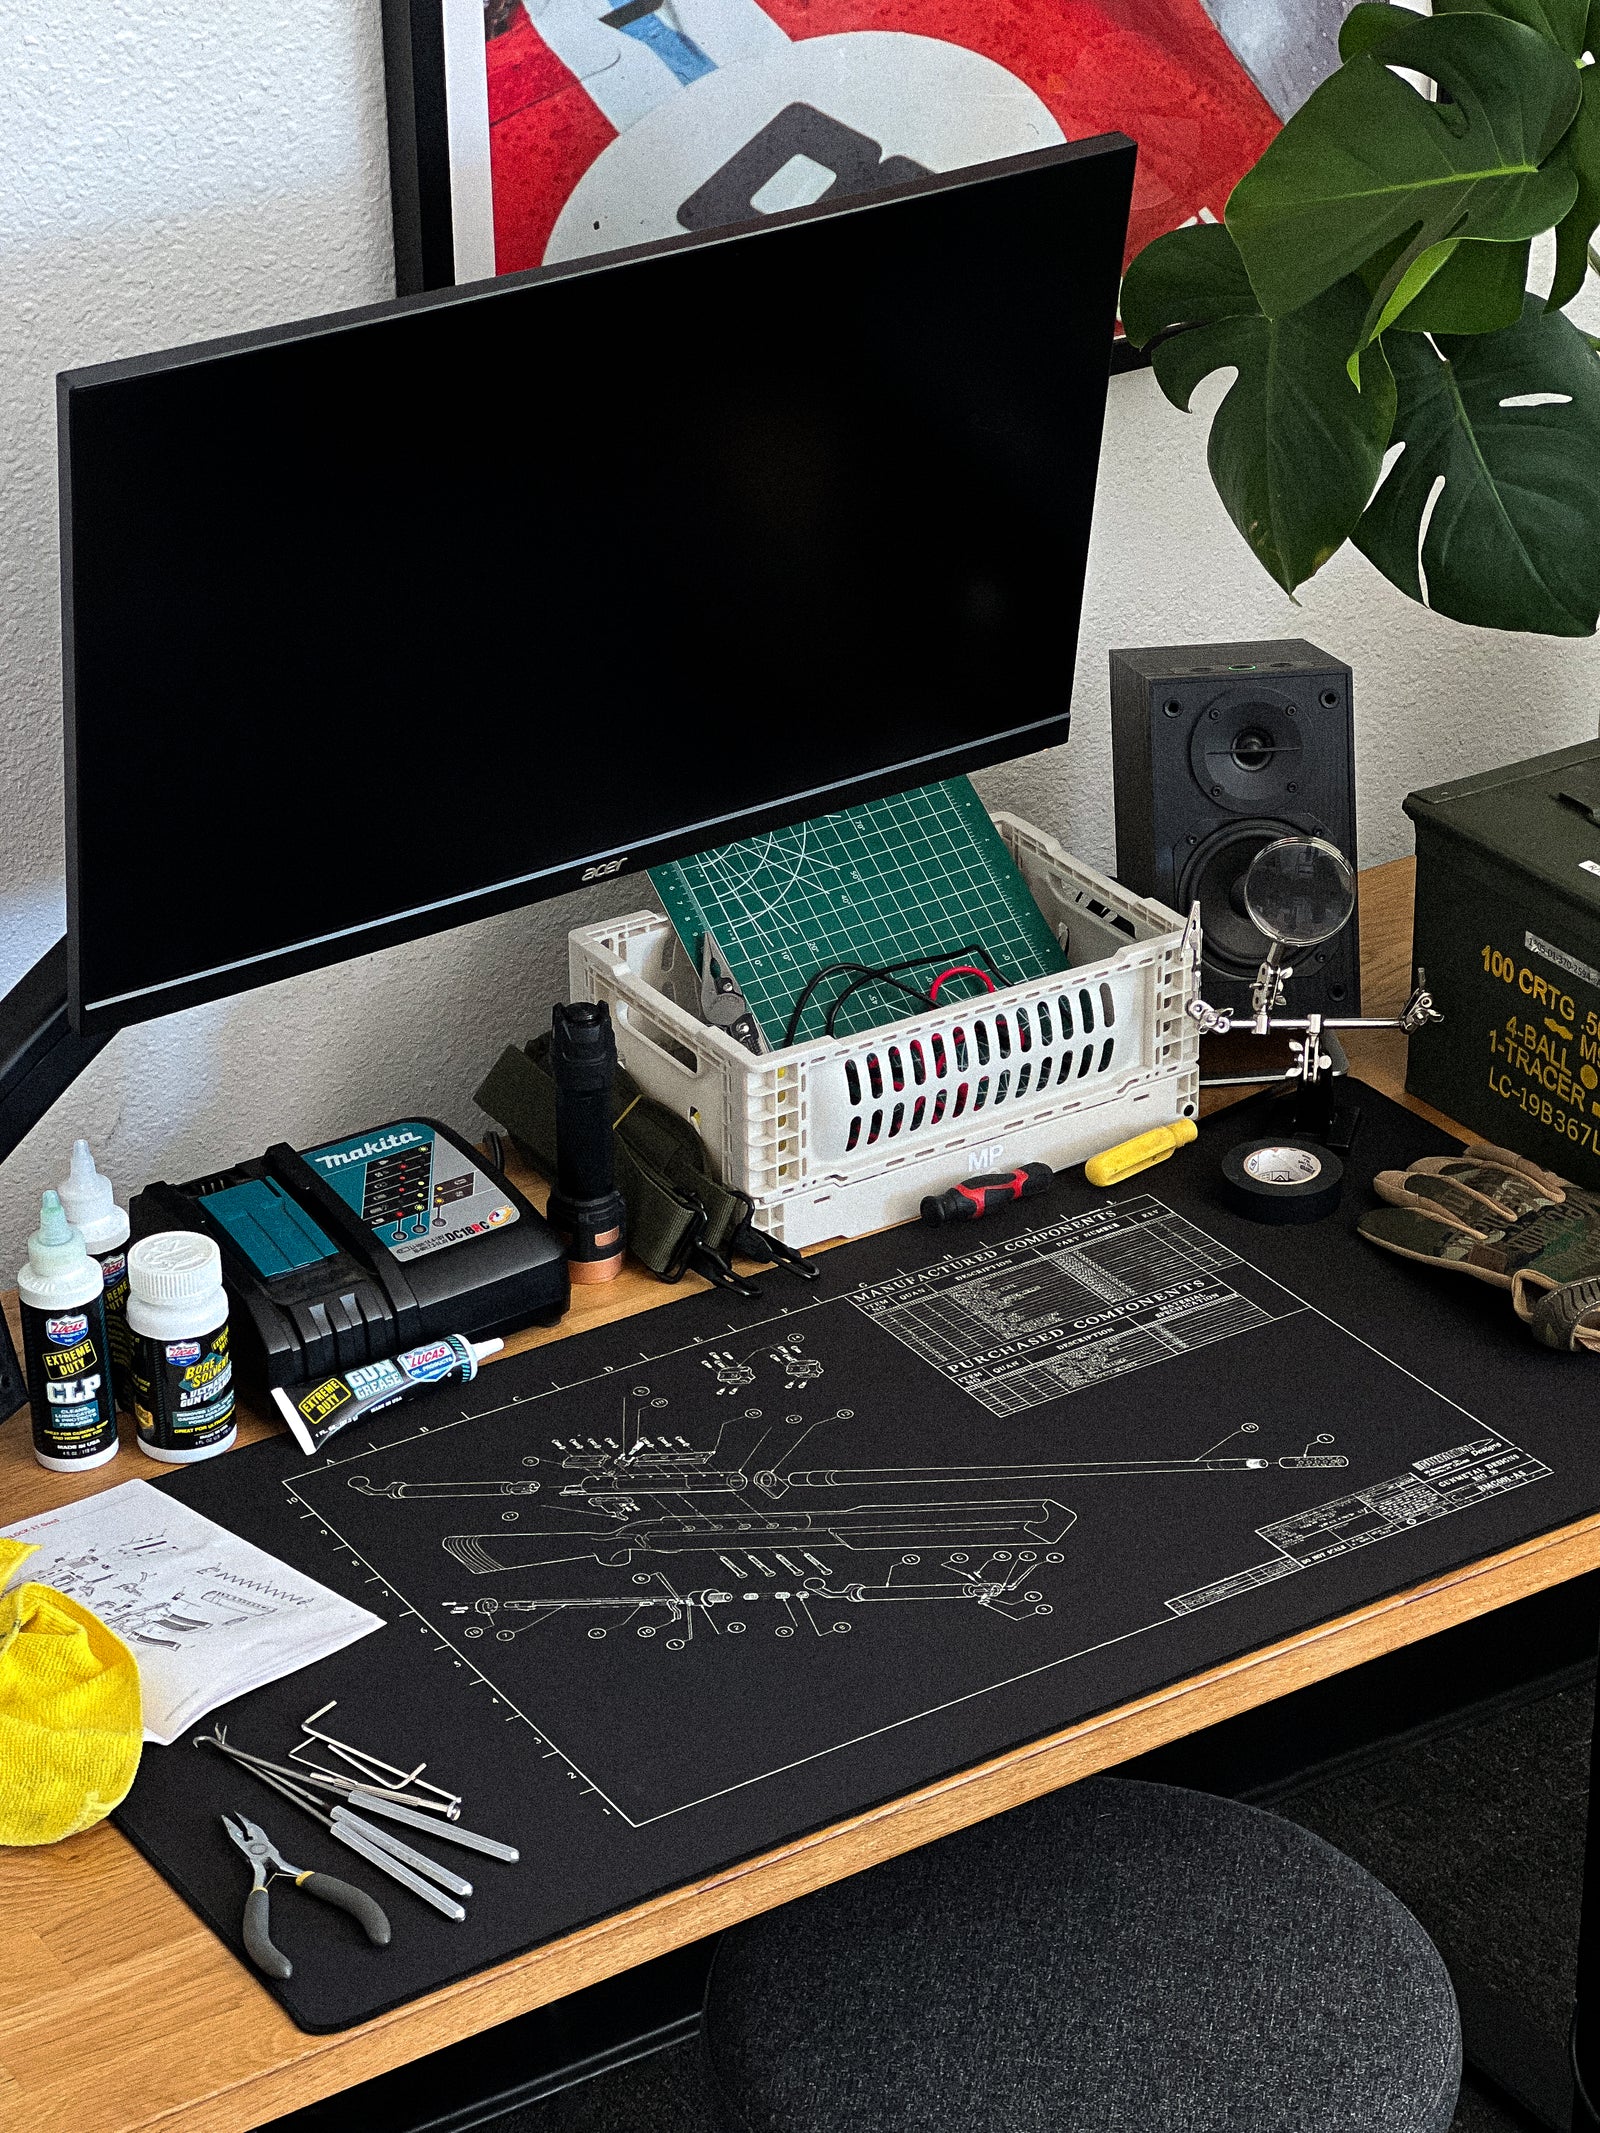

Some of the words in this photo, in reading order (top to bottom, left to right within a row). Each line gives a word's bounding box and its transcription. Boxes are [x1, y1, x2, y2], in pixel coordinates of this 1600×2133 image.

[581, 857, 628, 881] acer
[1481, 945, 1515, 984] 100
[1518, 968, 1575, 1021] CRTG
[1580, 1010, 1600, 1040] .5
[1506, 1016, 1572, 1077] 4-BALL
[1489, 1029, 1585, 1113] 1-TRACER
[968, 1144, 1004, 1172] MP
[444, 1220, 490, 1242] DC18RC
[1055, 1234, 1080, 1247] PART
[1083, 1222, 1121, 1239] NUMBER
[853, 1250, 998, 1304] MANUFACTURED
[1004, 1210, 1117, 1251] COMPONENTS
[954, 1258, 1012, 1282] DESCRIPTION
[105, 1295, 124, 1311] UTY
[106, 1280, 128, 1302] REME
[1158, 1292, 1207, 1311] MATERIAL
[864, 1299, 889, 1311] ITEM
[1154, 1293, 1219, 1318] SPECIFICATION
[51, 1321, 84, 1333] LUCAS
[946, 1328, 1065, 1374] PURCHASED
[1073, 1279, 1205, 1330] COMPONENTS
[1056, 1327, 1115, 1351] DESCRIPTION
[45, 1342, 92, 1366] EXTREME
[411, 1346, 446, 1368] LUCAS
[59, 1358, 85, 1376] DUTY
[185, 1357, 215, 1381] BORE
[349, 1360, 396, 1388] GUN
[959, 1371, 983, 1384] ITEM
[46, 1373, 101, 1405] CLP
[302, 1379, 340, 1413] EXTREME
[353, 1373, 401, 1400] GREASE
[180, 1397, 201, 1408] GUN
[316, 1393, 340, 1415] DUTY
[1470, 1441, 1502, 1457] Designs
[1438, 1467, 1485, 1488] GUNMETAL
[286, 1496, 299, 1505] 10
[453, 1660, 462, 1668] 5
[533, 1737, 542, 1745] 3
[567, 1771, 577, 1780] 2
